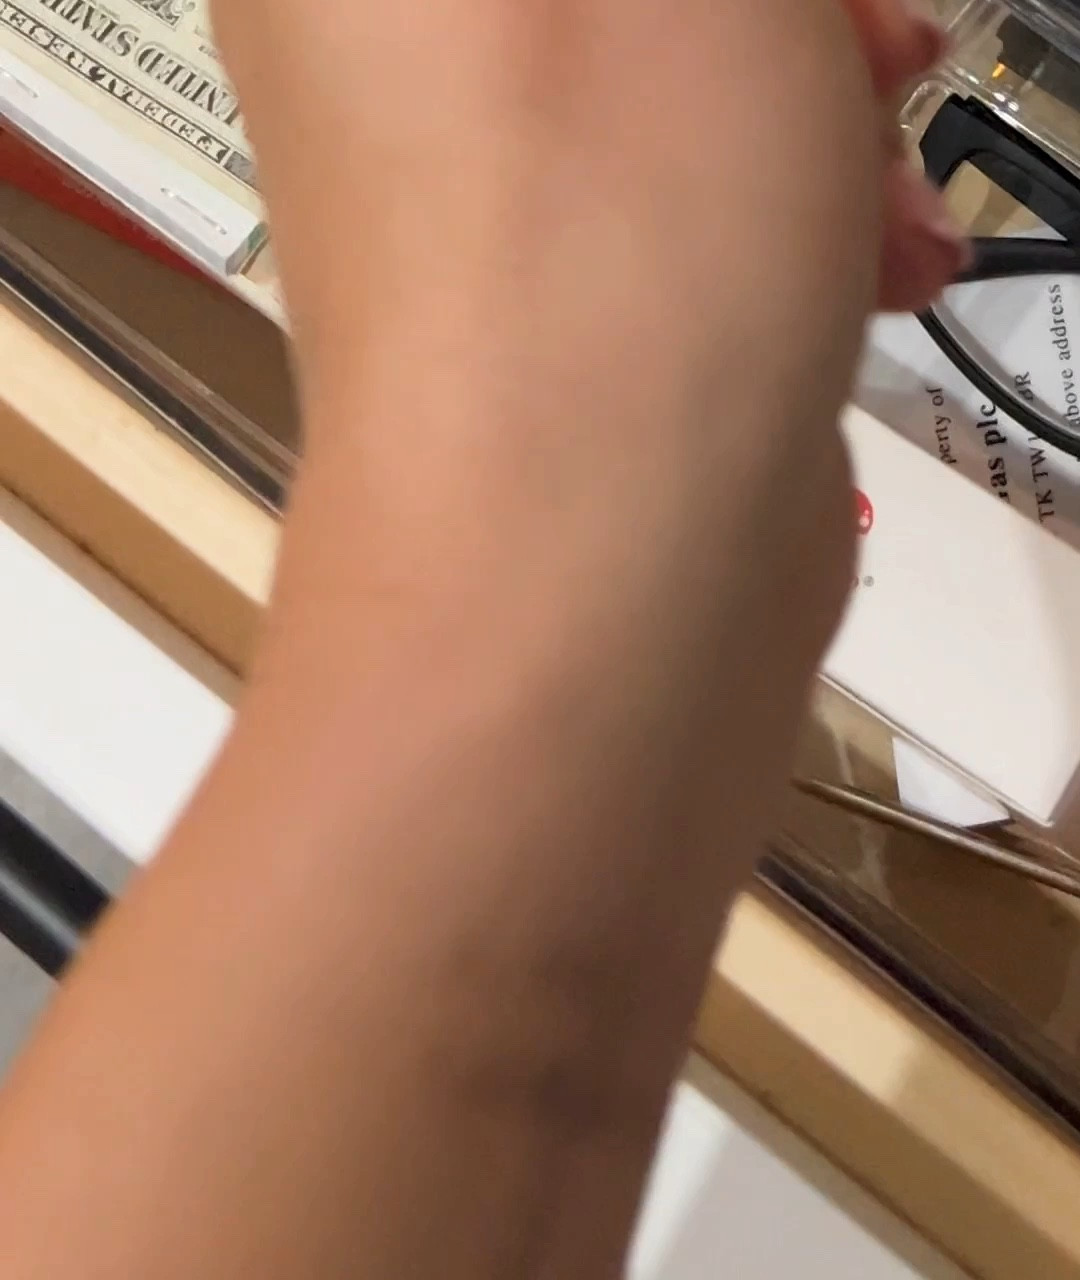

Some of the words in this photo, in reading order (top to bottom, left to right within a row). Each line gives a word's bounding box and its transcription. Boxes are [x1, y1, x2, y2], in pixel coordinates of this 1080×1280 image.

[1049, 283, 1072, 361] address
[925, 387, 945, 407] of
[934, 414, 957, 465] perty
[976, 403, 1007, 447] plc
